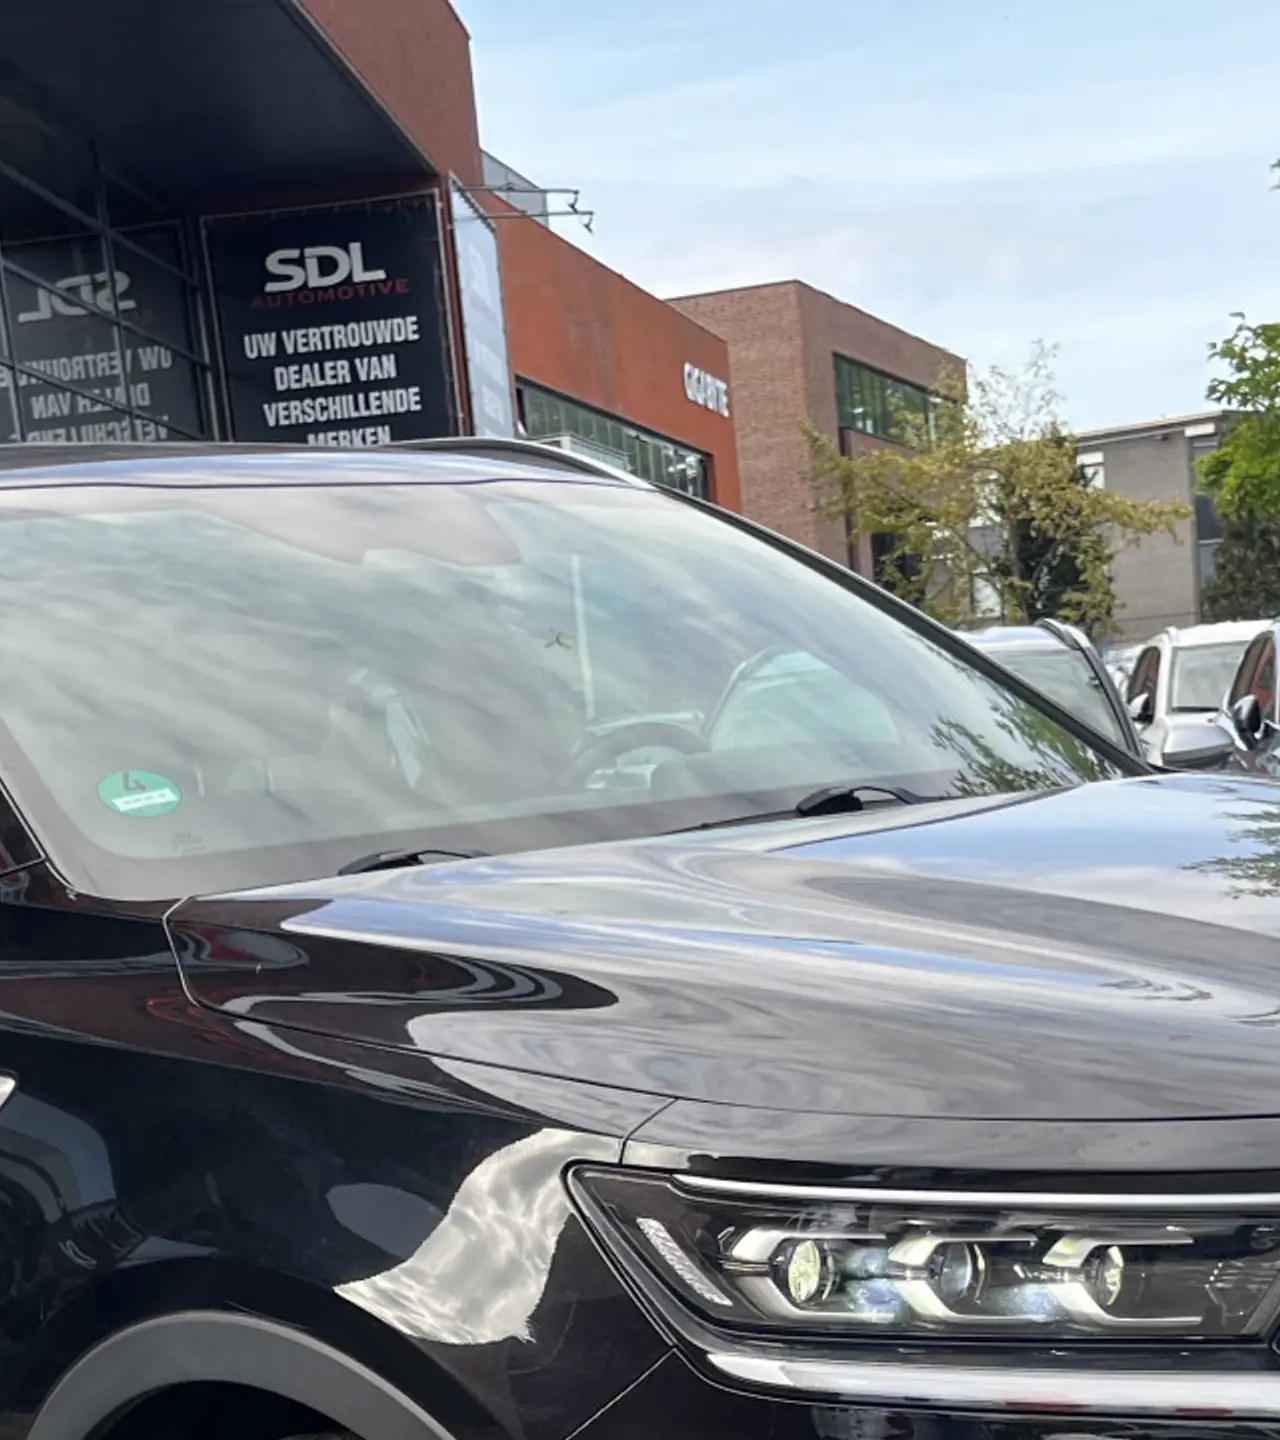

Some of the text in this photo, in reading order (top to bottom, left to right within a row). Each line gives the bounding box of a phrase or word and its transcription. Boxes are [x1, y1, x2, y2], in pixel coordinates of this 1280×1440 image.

[264, 242, 387, 293] SDL
[250, 278, 409, 309] AUTOMOTIVE
[243, 315, 421, 360] UW VERTROUWDE
[274, 353, 398, 392] DEALER VAN
[263, 387, 423, 428] VERSCHILLENDE
